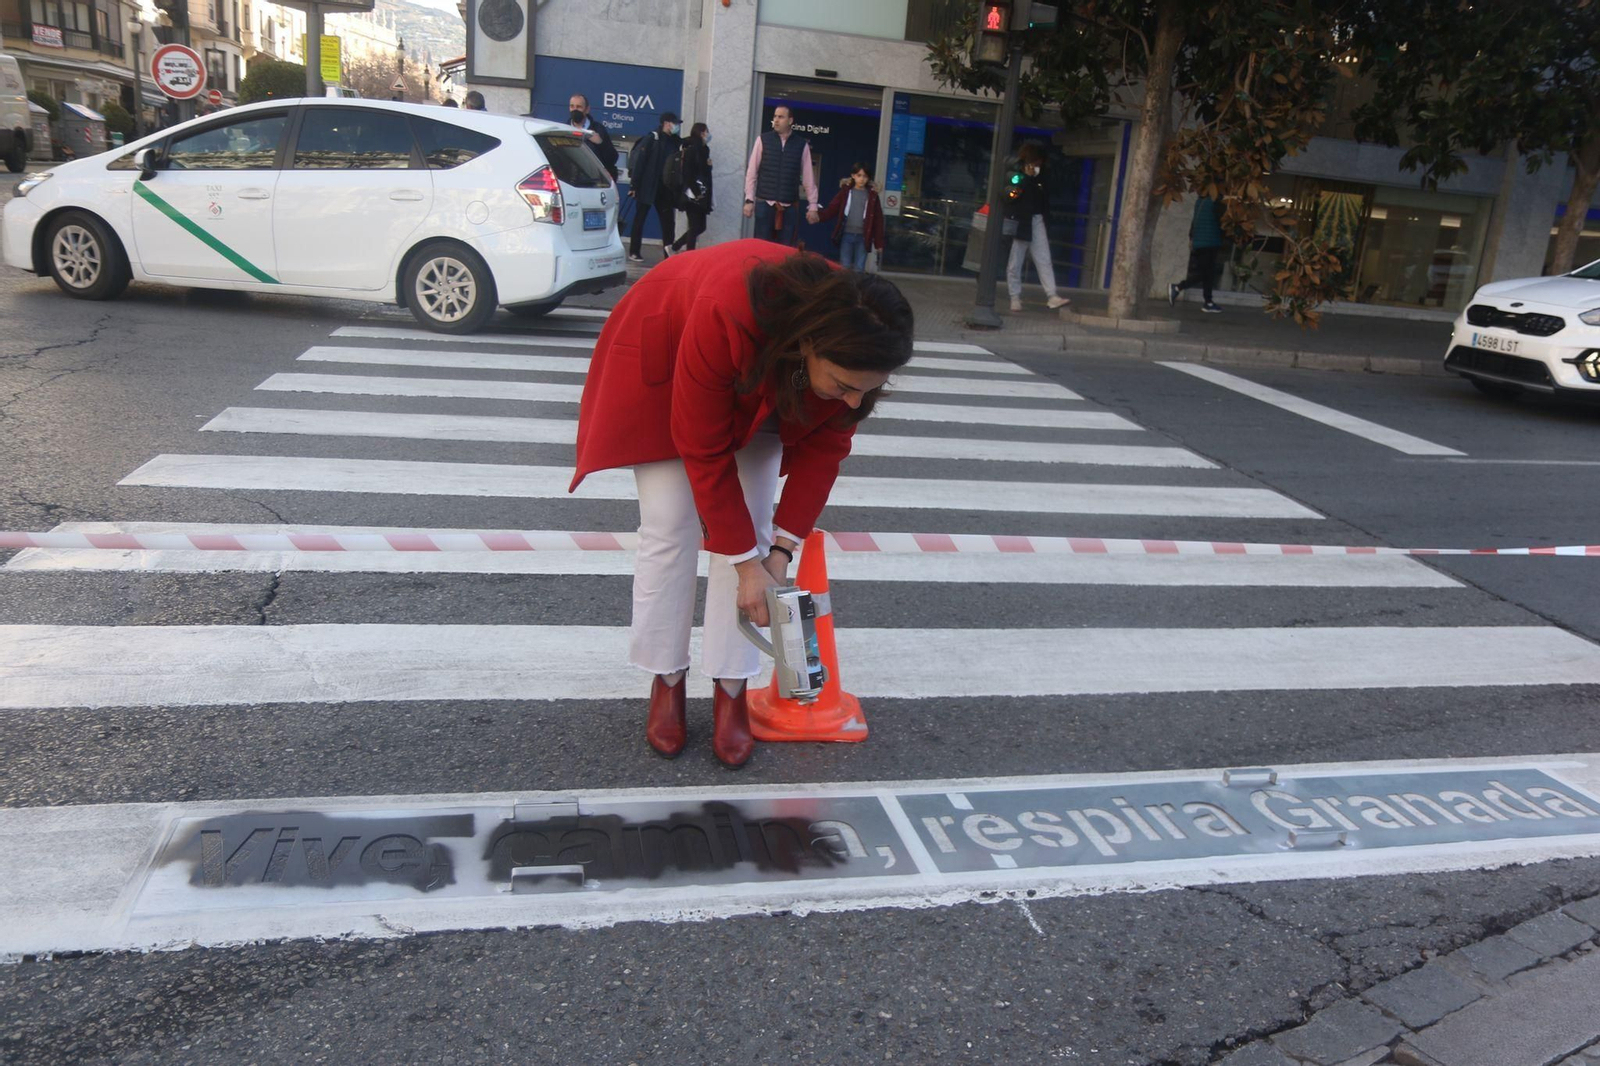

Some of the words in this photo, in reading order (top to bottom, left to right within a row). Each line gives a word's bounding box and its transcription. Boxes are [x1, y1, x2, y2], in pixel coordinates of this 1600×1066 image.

[603, 92, 655, 110] BBVA
[602, 120, 624, 129] Digital
[612, 112, 635, 122] Oficina
[791, 123, 806, 132] cina
[807, 124, 830, 135] Digital
[1477, 334, 1499, 350] 4598
[1500, 338, 1519, 353] LST
[921, 795, 1252, 857] respira
[1249, 779, 1600, 832] Granada
